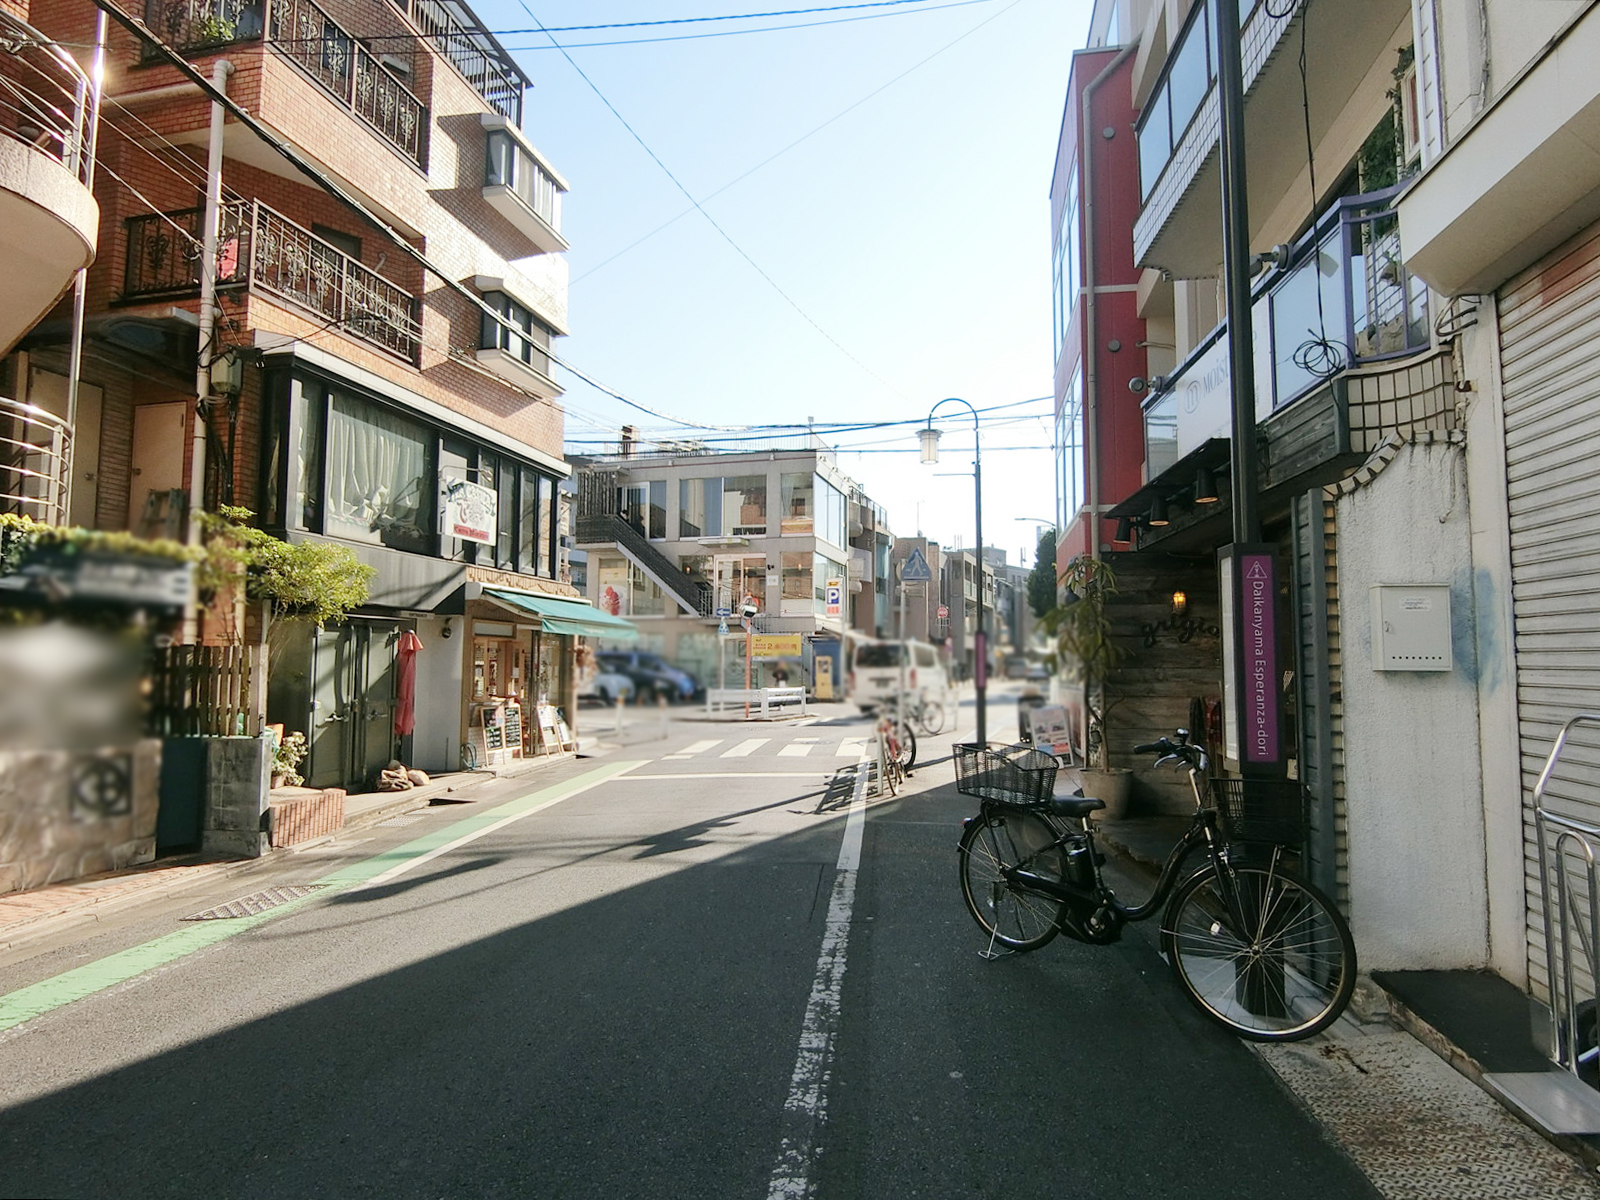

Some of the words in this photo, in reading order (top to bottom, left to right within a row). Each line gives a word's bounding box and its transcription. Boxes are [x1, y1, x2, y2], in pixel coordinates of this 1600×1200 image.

[828, 589, 839, 604] P
[1251, 581, 1265, 656] Daikanyama
[1253, 660, 1269, 755] Esperanza-dori
